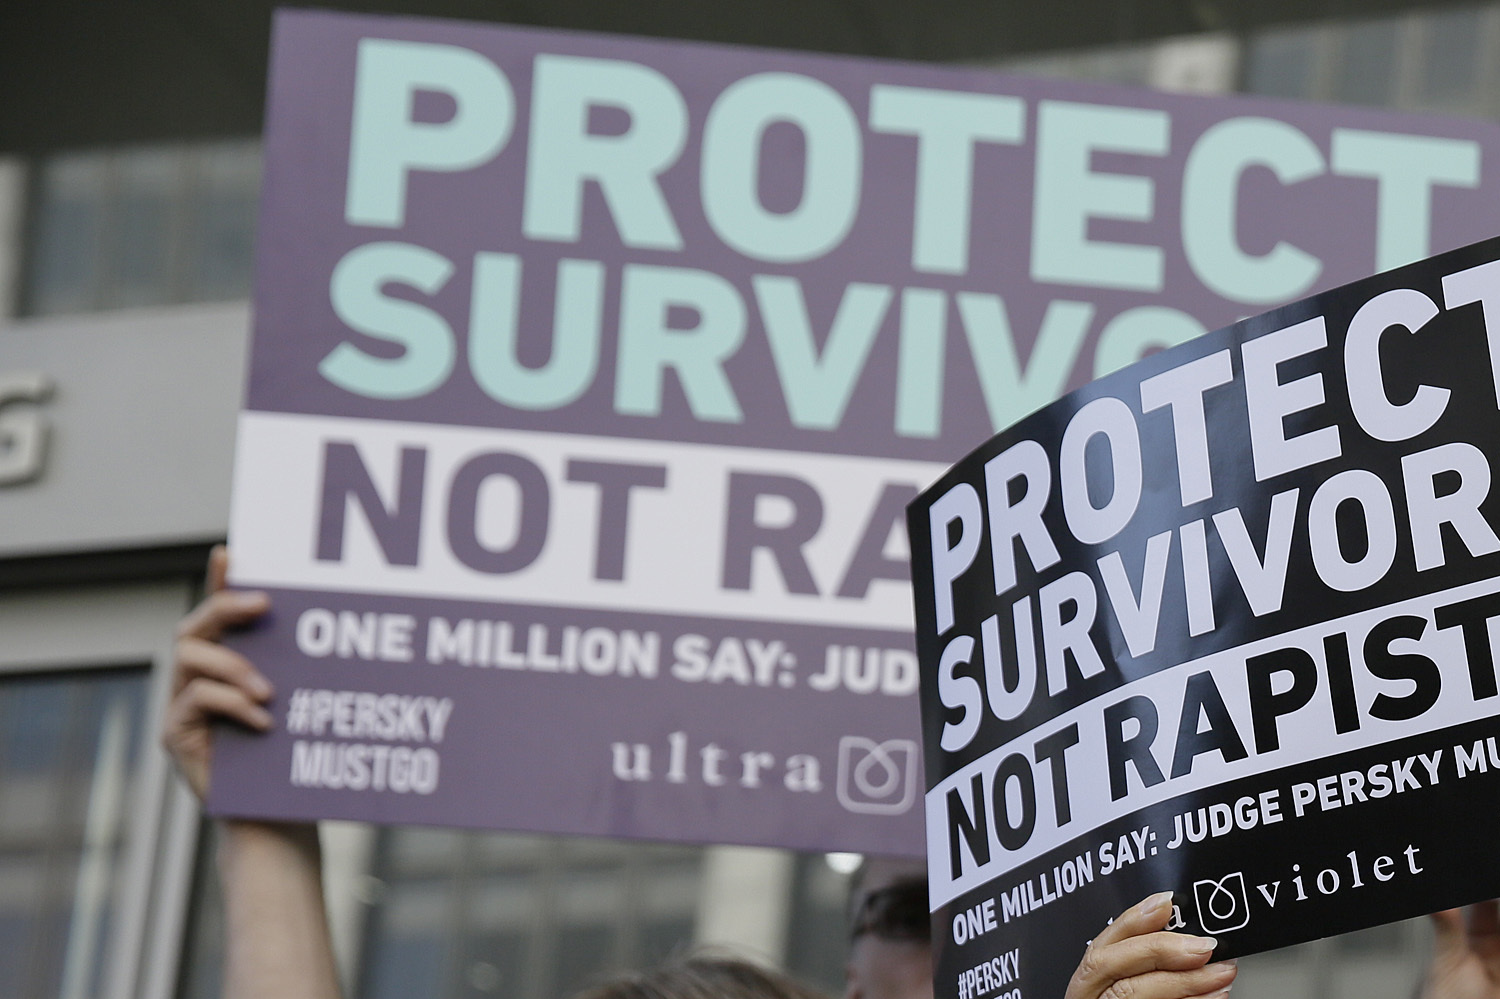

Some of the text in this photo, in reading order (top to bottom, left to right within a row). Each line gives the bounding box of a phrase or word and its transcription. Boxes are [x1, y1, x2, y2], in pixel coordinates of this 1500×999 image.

[345, 38, 1481, 304] PROTECT
[313, 439, 667, 583] NOT
[296, 608, 417, 662] ONE
[426, 617, 660, 679] MILLION
[671, 634, 797, 688] SAY:
[287, 688, 453, 743] #PERSKY
[290, 740, 440, 795] MUSTGO
[612, 731, 823, 793] ultra
[946, 722, 1081, 882] NOT
[953, 898, 998, 946] ONE
[1000, 851, 1094, 923] MILLION
[1099, 826, 1158, 875] SAY:
[1166, 790, 1283, 850] JUDGE
[1291, 749, 1443, 817] PERSKY
[1257, 843, 1423, 908] violet
